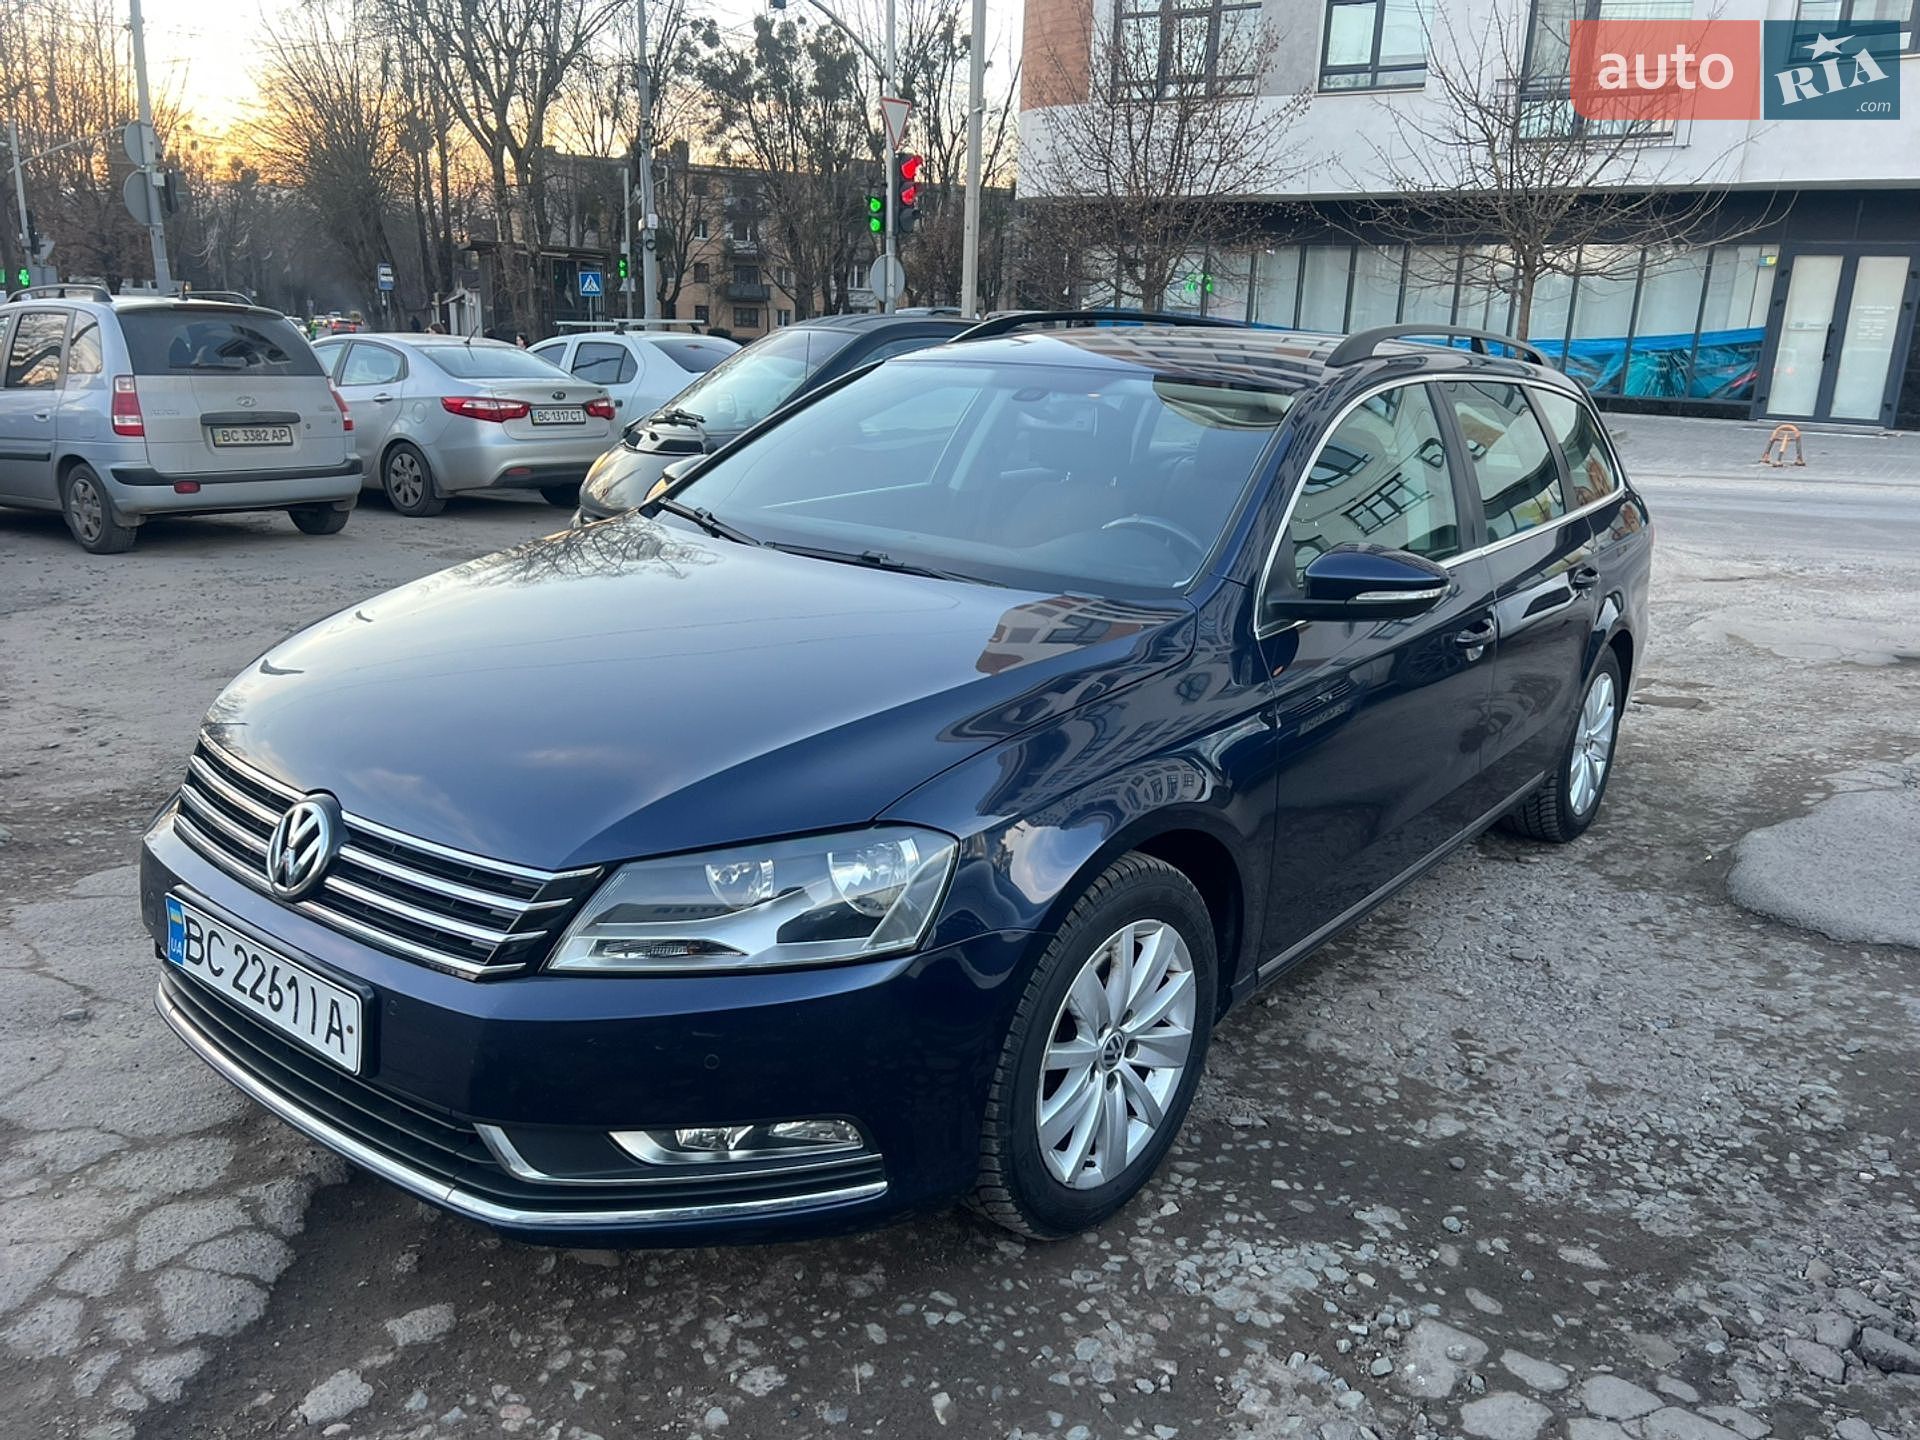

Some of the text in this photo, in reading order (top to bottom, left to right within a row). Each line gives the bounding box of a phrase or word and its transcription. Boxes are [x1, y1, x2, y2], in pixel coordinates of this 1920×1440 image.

[537, 410, 551, 421] BC
[570, 410, 581, 421] CT
[222, 429, 288, 442] BC 3382 AP
[170, 938, 183, 956] UA
[184, 914, 346, 1055] BC 2261 IA
